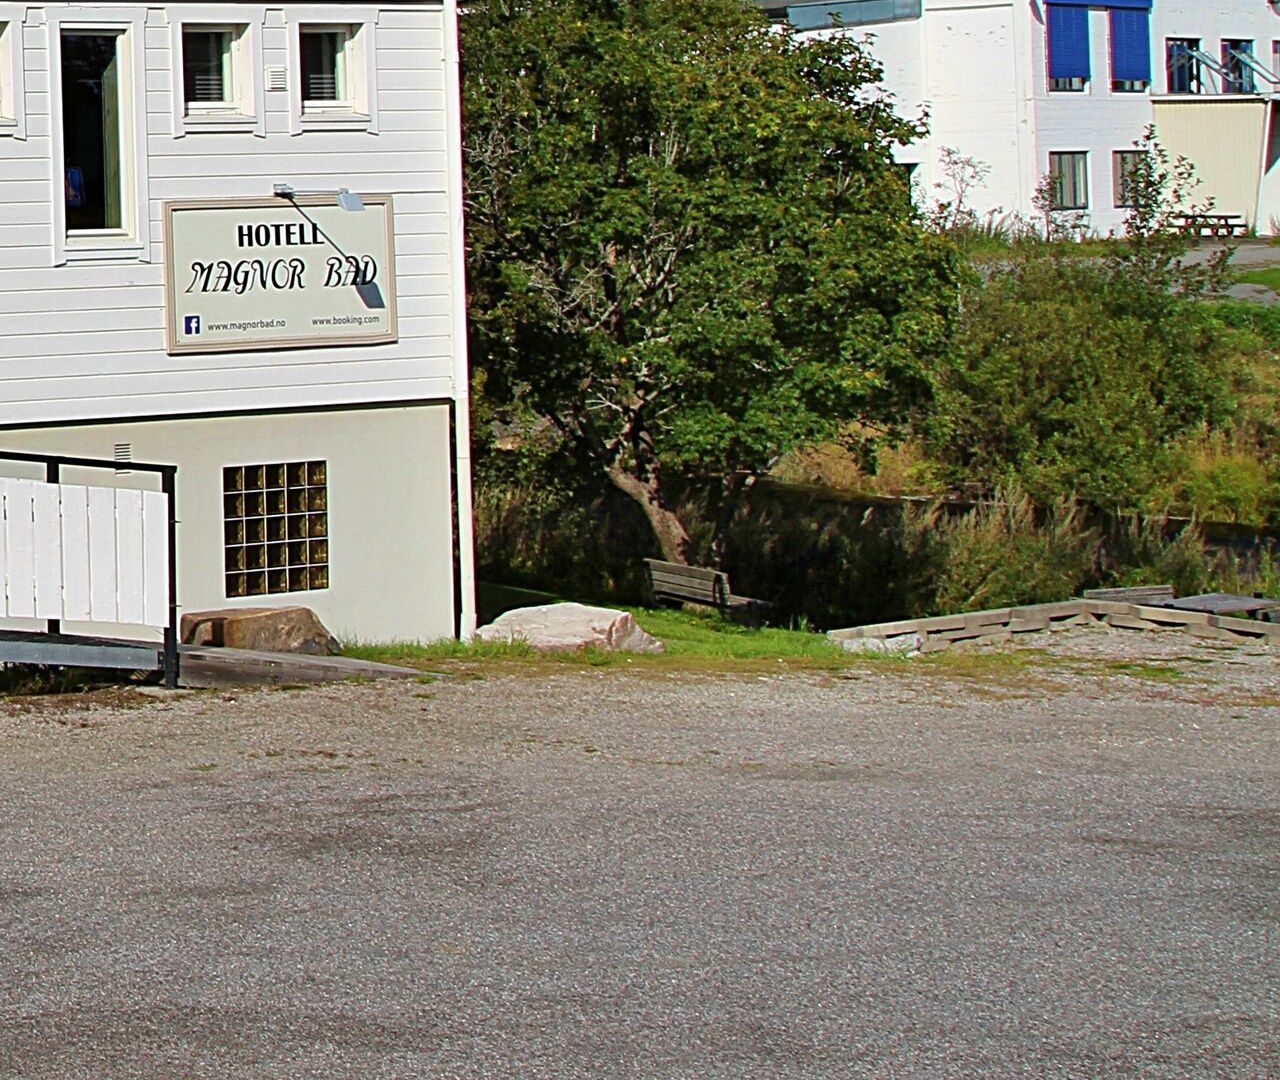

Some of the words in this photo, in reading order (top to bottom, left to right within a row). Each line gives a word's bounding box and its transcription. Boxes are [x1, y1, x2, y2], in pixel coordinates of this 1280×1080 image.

[237, 222, 325, 248] HOTELL
[185, 258, 306, 294] MAGNOR
[323, 255, 378, 288] BAD
[207, 319, 286, 332] www.magnorbad.no
[311, 315, 380, 327] www.booking.com
